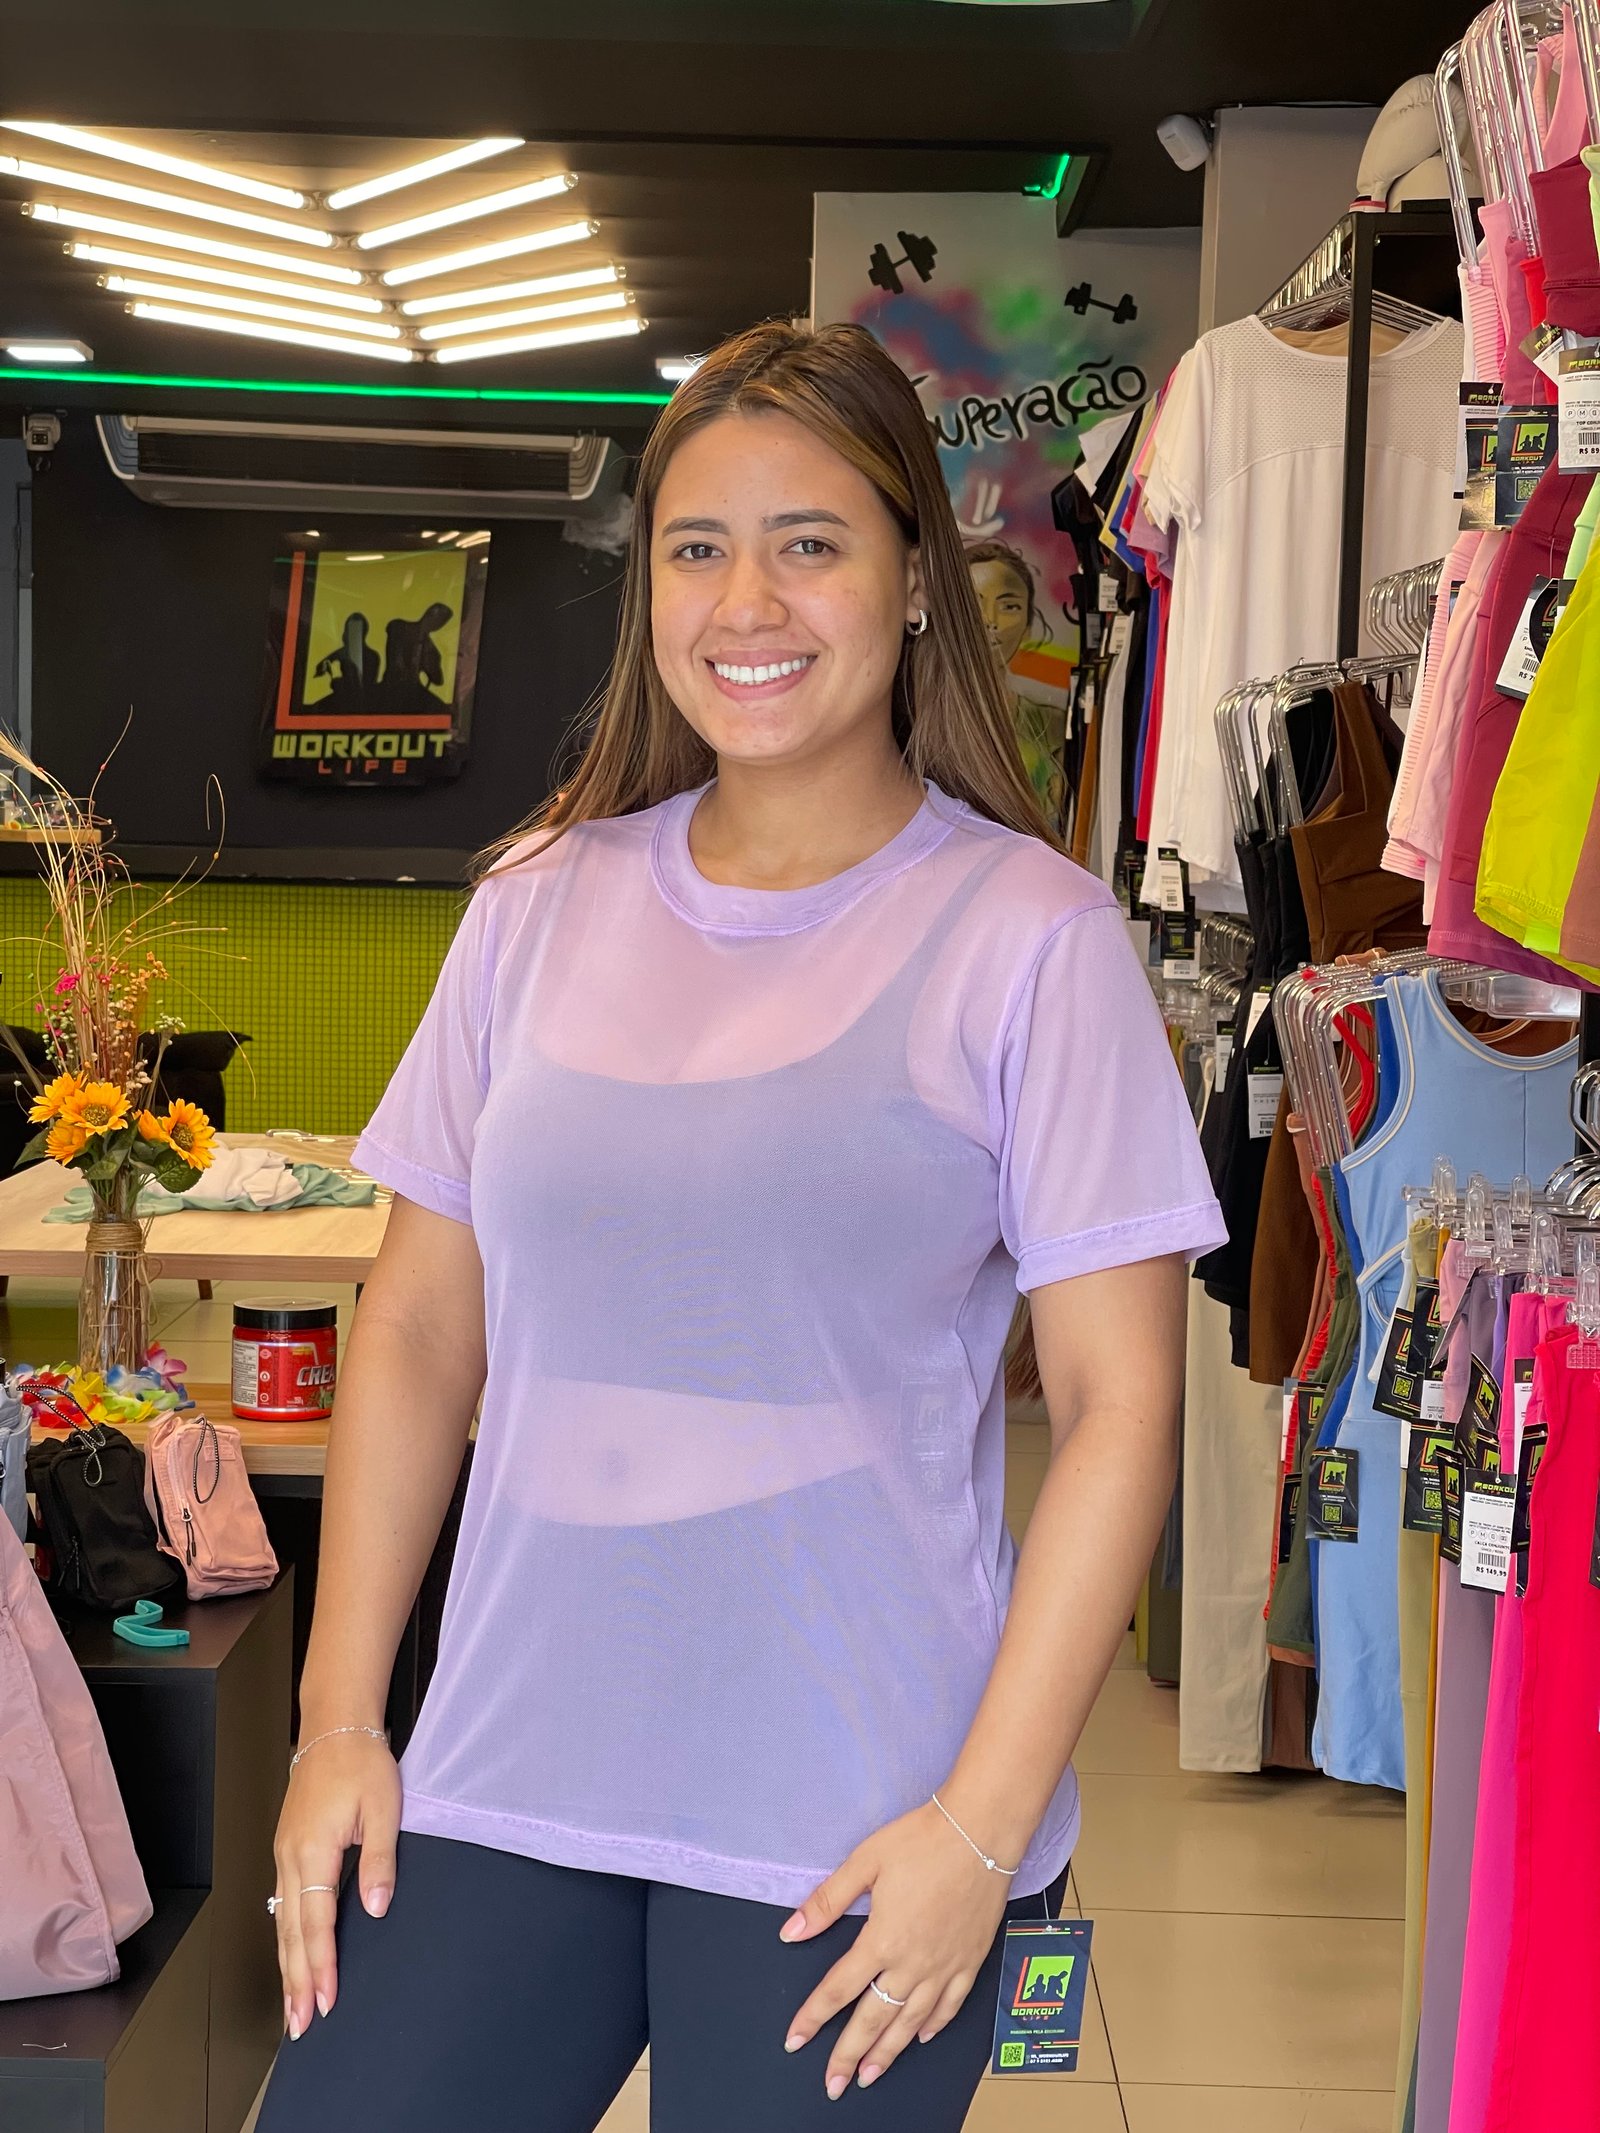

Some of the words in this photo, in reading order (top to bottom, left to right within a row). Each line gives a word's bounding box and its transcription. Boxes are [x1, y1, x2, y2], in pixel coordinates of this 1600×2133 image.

[911, 355, 1147, 447] uperação
[272, 734, 451, 758] WORKOUT
[318, 759, 408, 774] LIFE
[1011, 2008, 1063, 2016] WORKOUT
